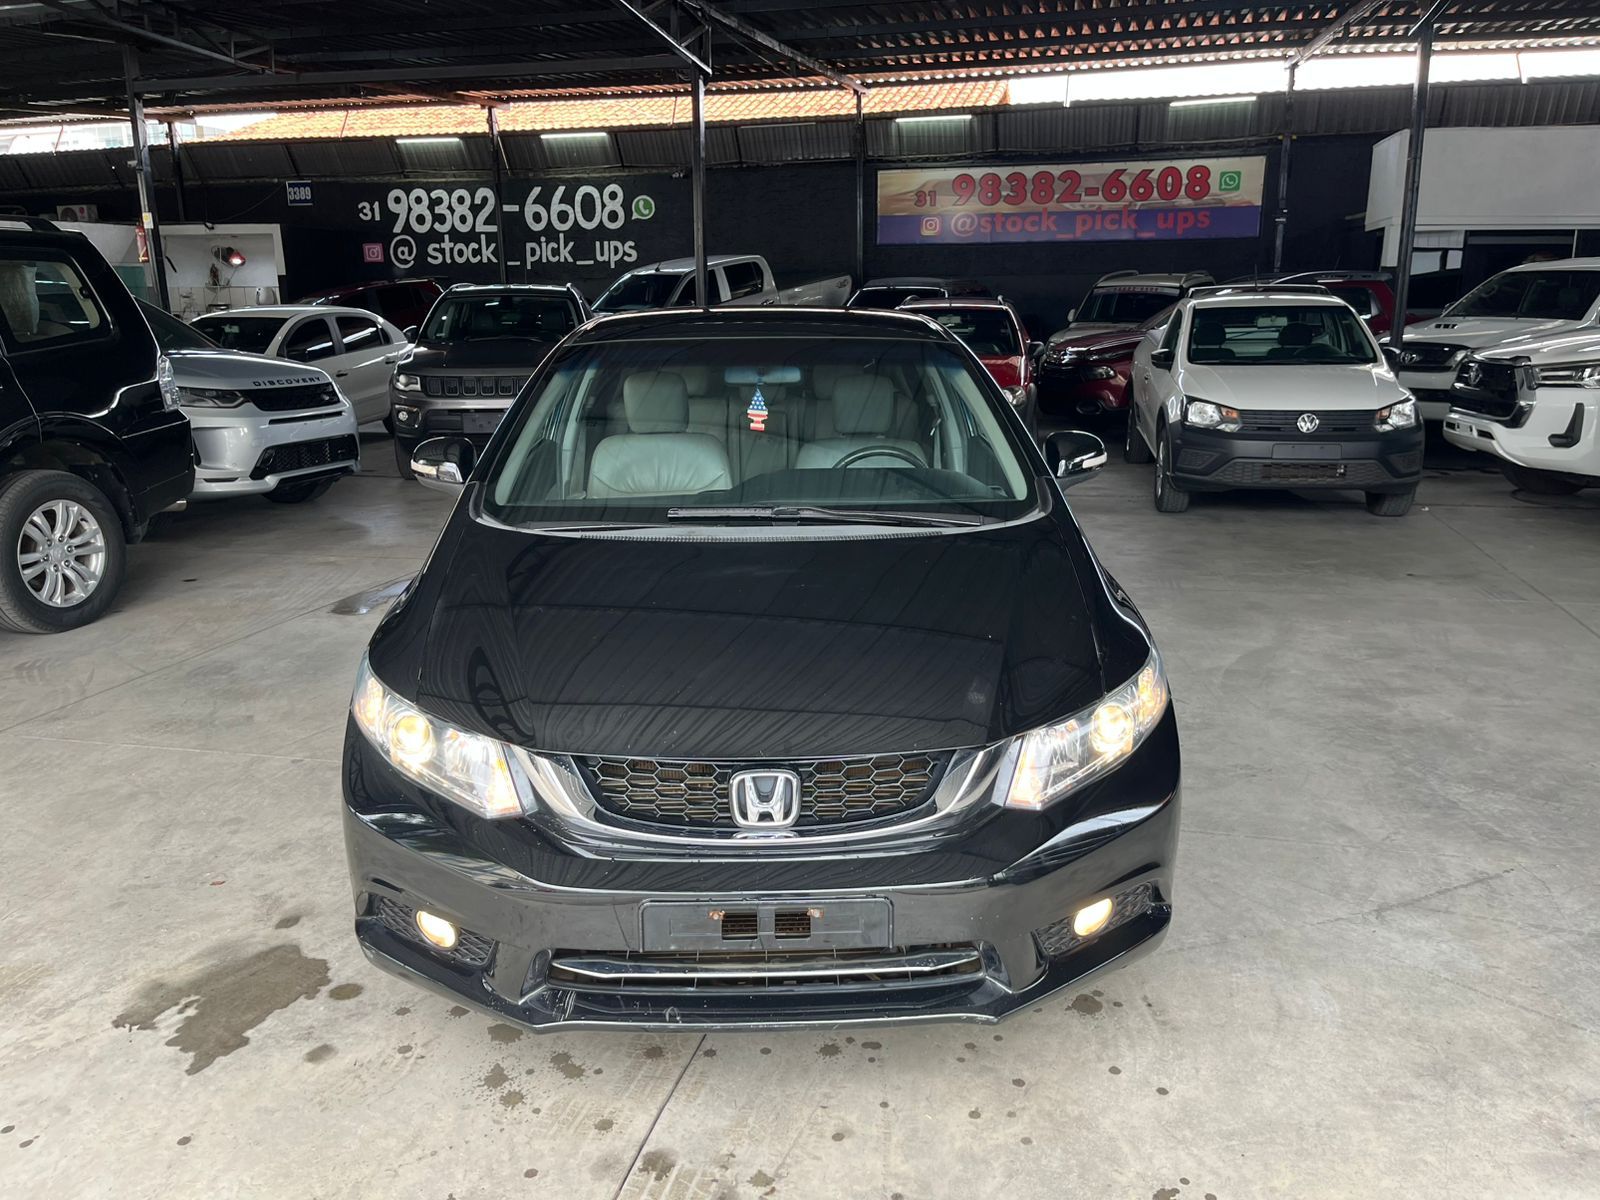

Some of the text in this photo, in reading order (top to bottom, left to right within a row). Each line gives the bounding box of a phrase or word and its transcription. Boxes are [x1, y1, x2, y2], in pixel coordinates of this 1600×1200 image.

[288, 186, 312, 200] 3389
[914, 165, 1212, 207] 31 98382-6608
[358, 183, 625, 233] 31 98382-6608
[951, 207, 1211, 239] @stock_pick_ups
[253, 376, 320, 387] DISCOVERY
